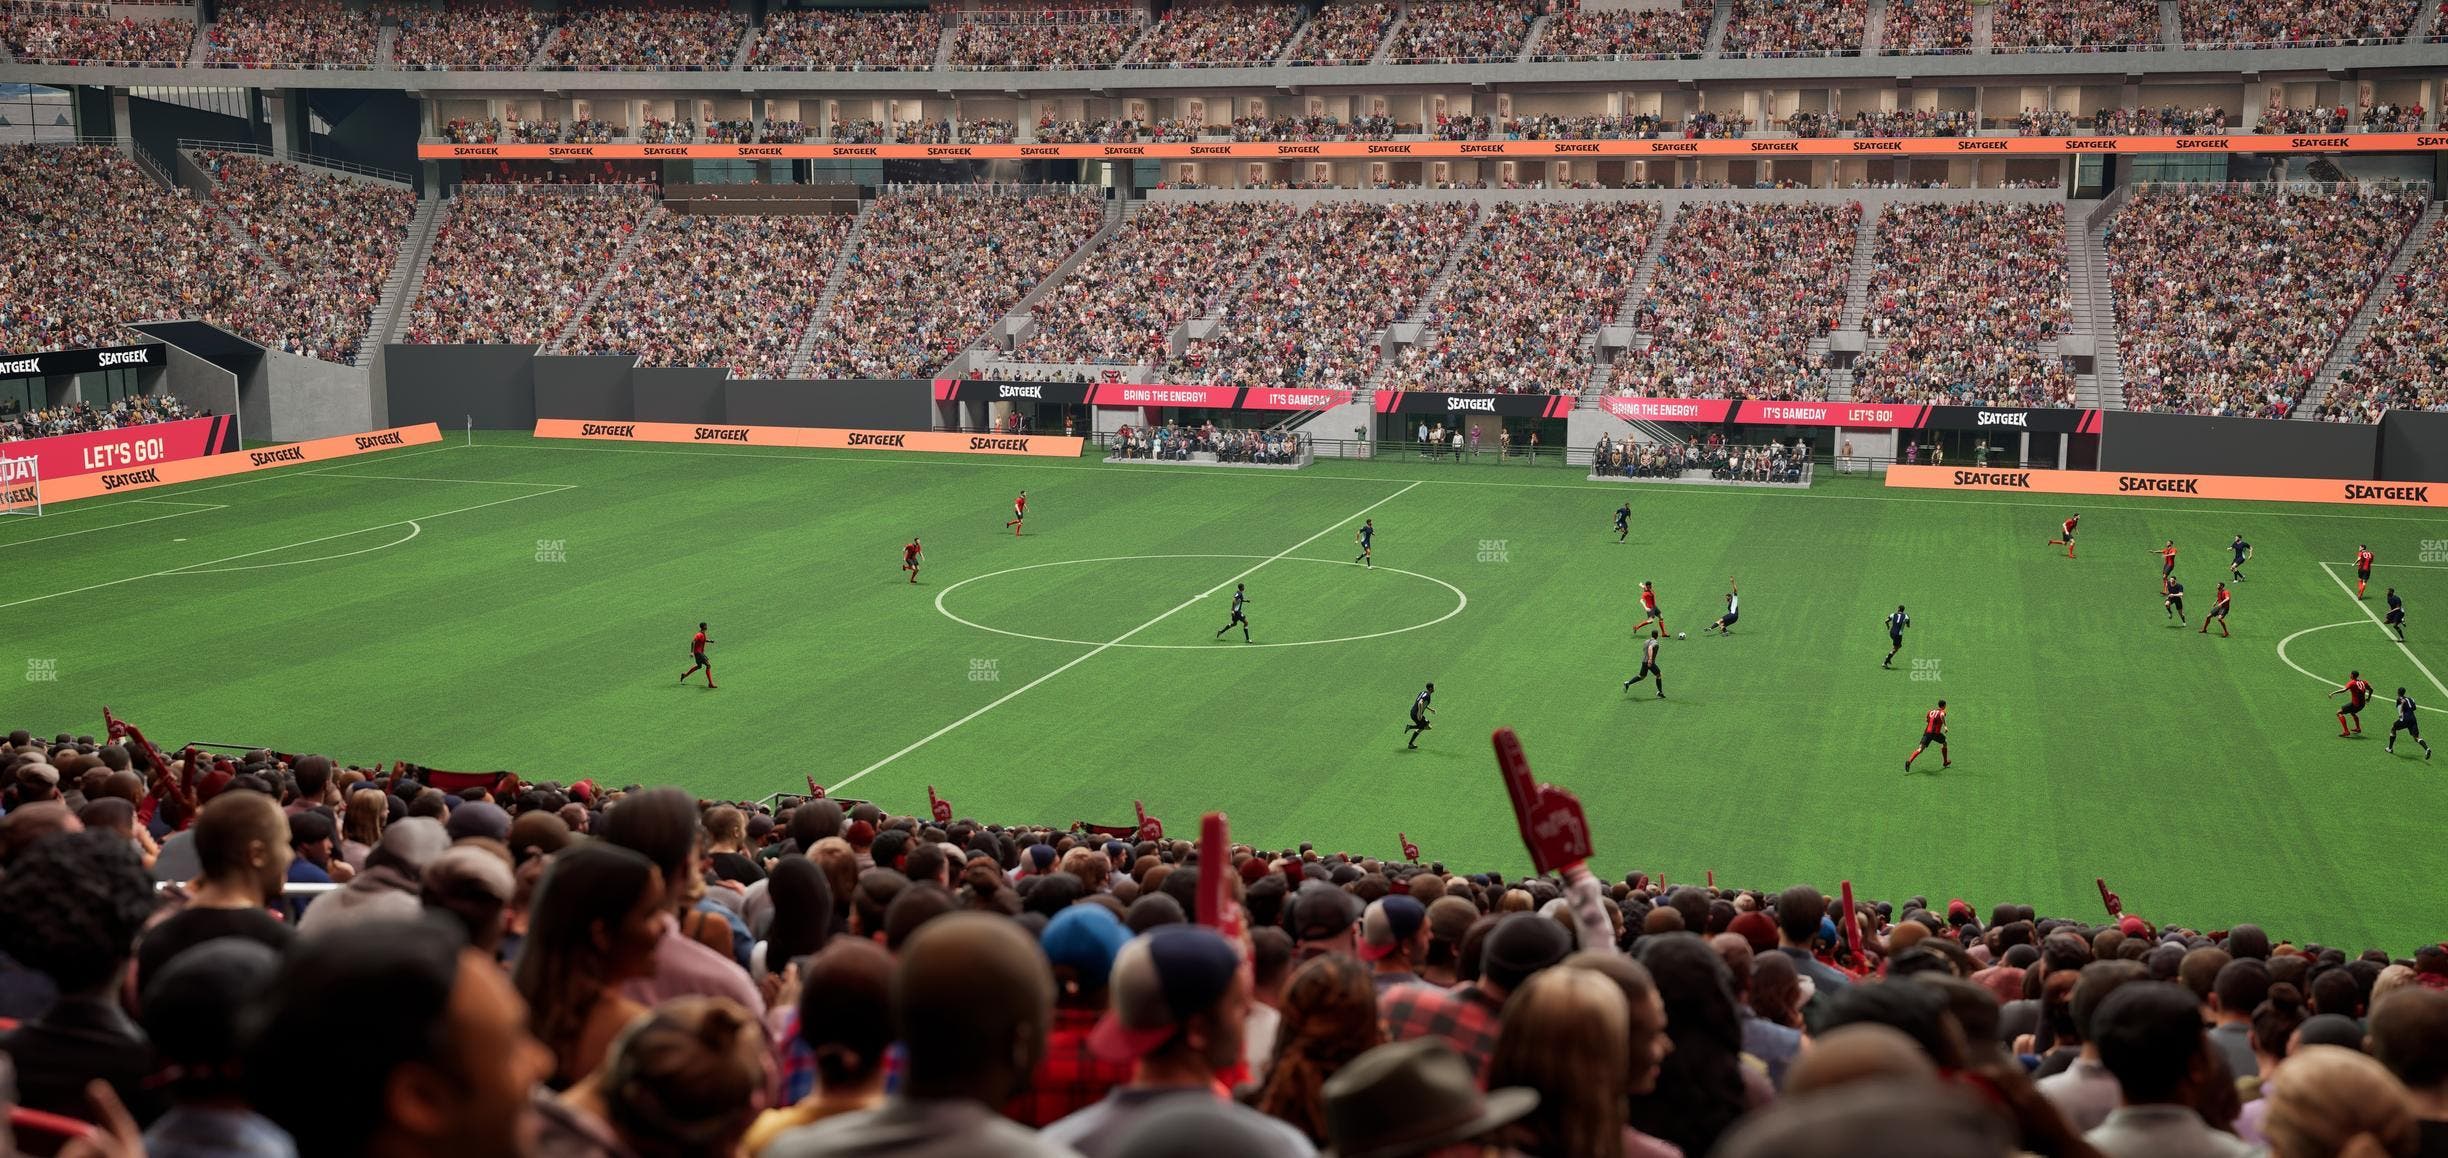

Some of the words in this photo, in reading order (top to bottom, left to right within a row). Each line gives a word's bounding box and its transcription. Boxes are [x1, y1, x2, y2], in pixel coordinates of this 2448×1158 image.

[1554, 143, 1600, 153] SEATGEEK
[1651, 143, 1698, 152] SEATGEEK
[1751, 142, 1799, 151] SEATGEEK
[1853, 141, 1902, 151] SEATGEEK
[1958, 141, 2008, 150] SEATGEEK
[2065, 140, 2117, 150] SEATGEEK
[2176, 139, 2229, 149] SEATGEEK
[2292, 137, 2349, 148] SEATGEEK
[454, 147, 499, 156] SEATGEEK
[549, 147, 593, 156] SEATGEEK
[643, 147, 688, 156] SEATGEEK
[738, 147, 782, 156] SEATGEEK
[833, 147, 877, 156] SEATGEEK
[927, 147, 972, 156] SEATGEEK
[1020, 147, 1060, 156] SEATGEEK
[1104, 146, 1145, 155] SEATGEEK
[1190, 146, 1230, 155] SEATGEEK
[1278, 145, 1320, 154] SEATGEEK
[1368, 144, 1411, 154] SEATGEEK
[1460, 144, 1504, 153] SEATGEEK
[99, 349, 148, 366] SEATGEEK
[999, 384, 1042, 399] SEATGEEK
[1123, 390, 1151, 401] BRING
[1152, 391, 1169, 401] THE
[1170, 391, 1207, 403] ENERGY!
[1269, 394, 1287, 405] IT'S
[1288, 394, 1331, 405] GAMEDAY
[1447, 396, 1496, 412] SEATGEEK
[1612, 403, 1640, 415] BRING
[1641, 404, 1659, 415] THE
[1660, 405, 1698, 417] ENERGY!
[1763, 407, 1781, 419] IT'S
[1782, 408, 1827, 420] GAMEDAY
[1848, 410, 1875, 421] LET'S
[1876, 411, 1893, 422] GO!
[1977, 411, 2028, 427] SEATGEEK
[581, 423, 635, 438] SEATGEEK
[694, 427, 750, 442] SEATGEEK
[355, 431, 404, 449] SEATGEEK
[847, 432, 905, 448] SEATGEEK
[969, 436, 1030, 452] SEATGEEK
[84, 443, 131, 469] LET'S
[135, 438, 164, 462] GO!
[251, 446, 304, 465] SEATGEEK
[0, 455, 38, 482] DAY
[102, 469, 160, 490] SEATGEEK
[1953, 470, 2030, 488] SEATGEEK
[2118, 476, 2198, 495] SEATGEEK
[2344, 483, 2428, 503] SEATGEEK
